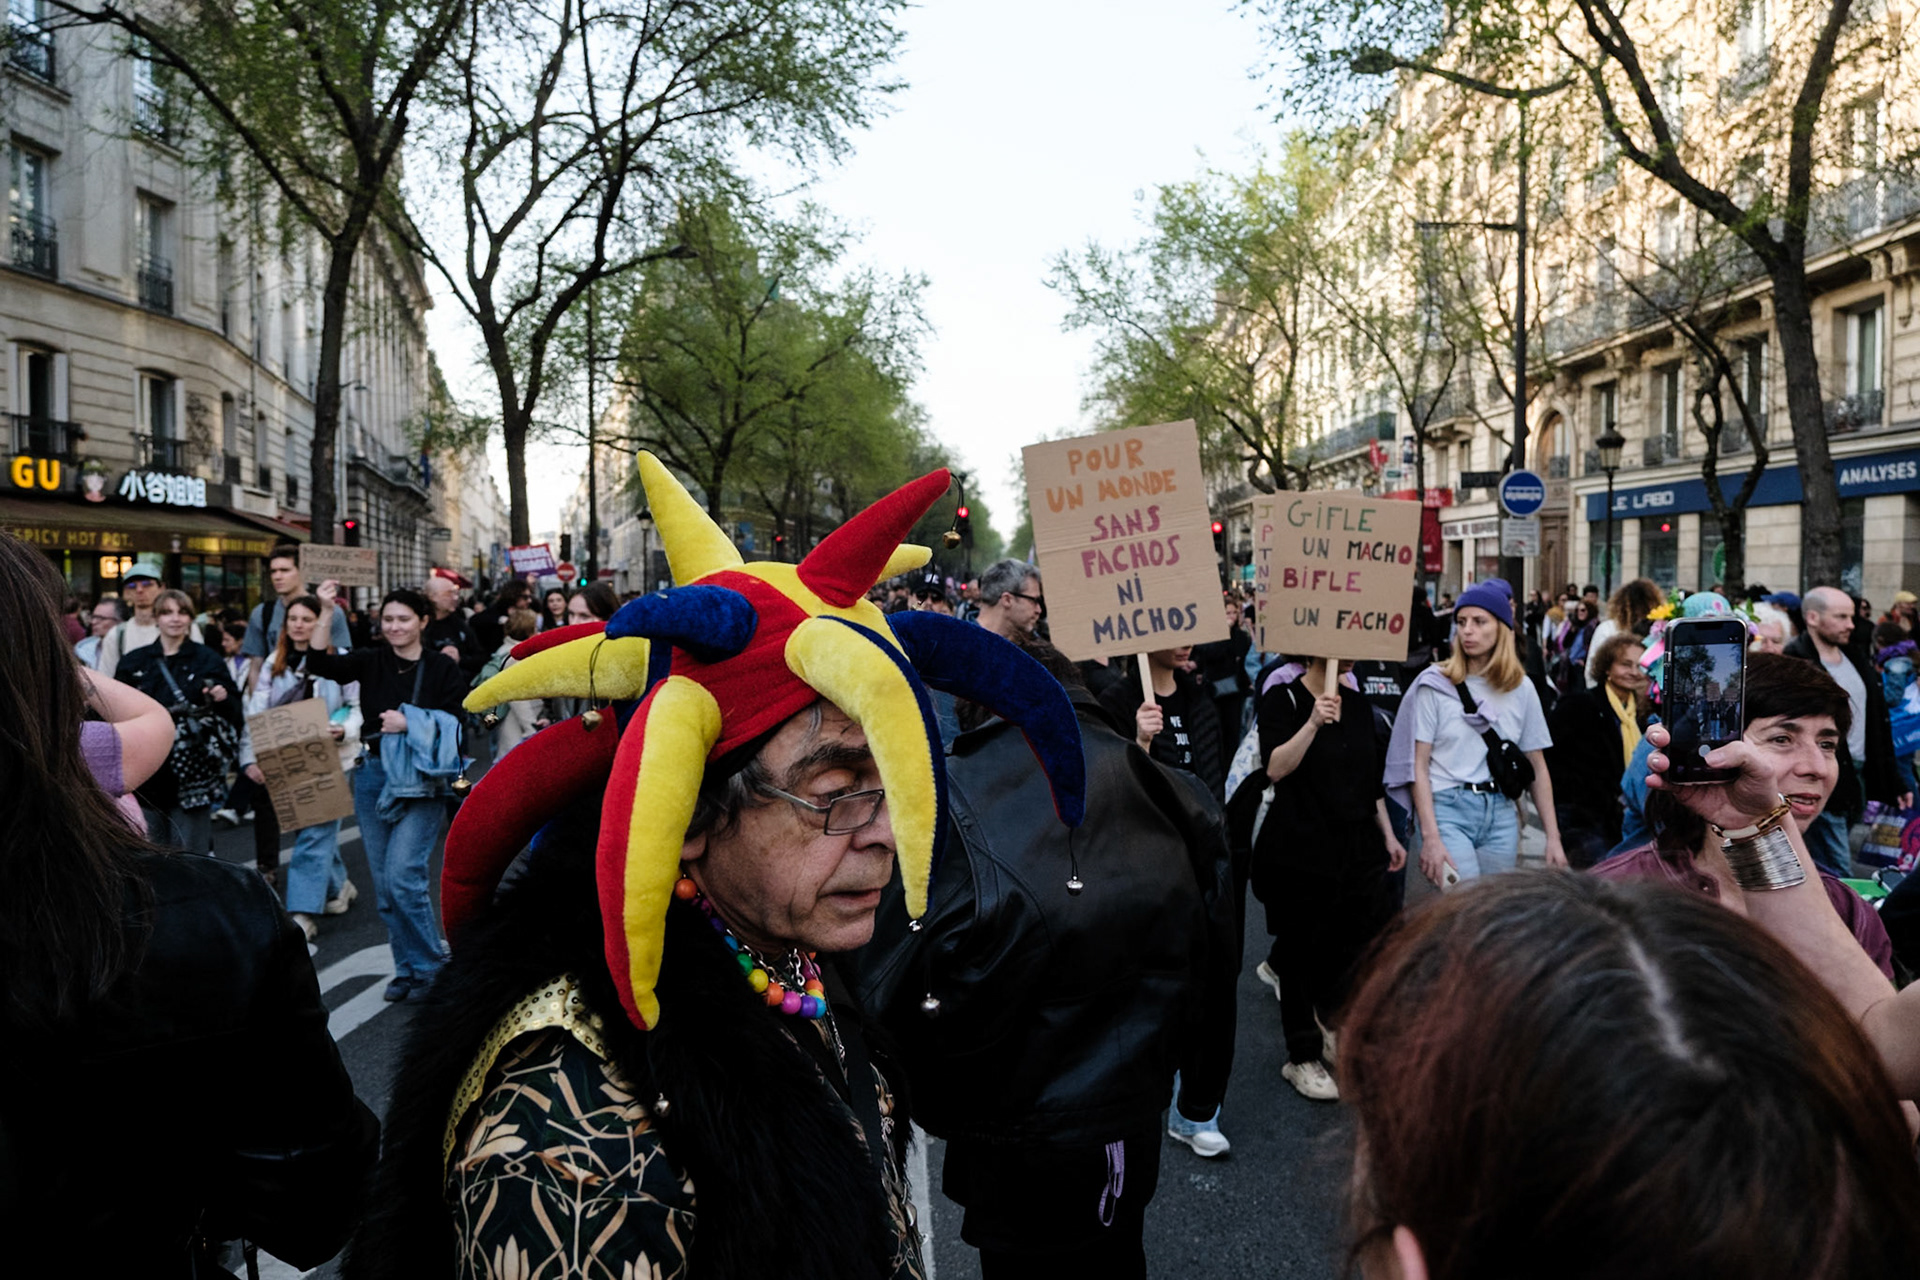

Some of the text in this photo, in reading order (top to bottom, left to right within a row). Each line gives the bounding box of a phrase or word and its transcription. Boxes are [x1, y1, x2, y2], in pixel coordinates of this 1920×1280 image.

[11, 455, 61, 491] GU
[1067, 438, 1144, 476] POUR
[1839, 461, 1917, 486] ANALYSES
[119, 469, 207, 508] 小谷姐姐
[1046, 469, 1177, 513] UN MONDE
[1633, 491, 1674, 509] LABO
[66, 531, 97, 546] HOT
[1090, 505, 1160, 542] SANS
[1081, 534, 1180, 578] FACHOS
[1303, 537, 1413, 565] UN MACHO
[1093, 603, 1197, 644] MACHOS
[1293, 607, 1405, 635] UN FACHO
[293, 785, 317, 805] DU
